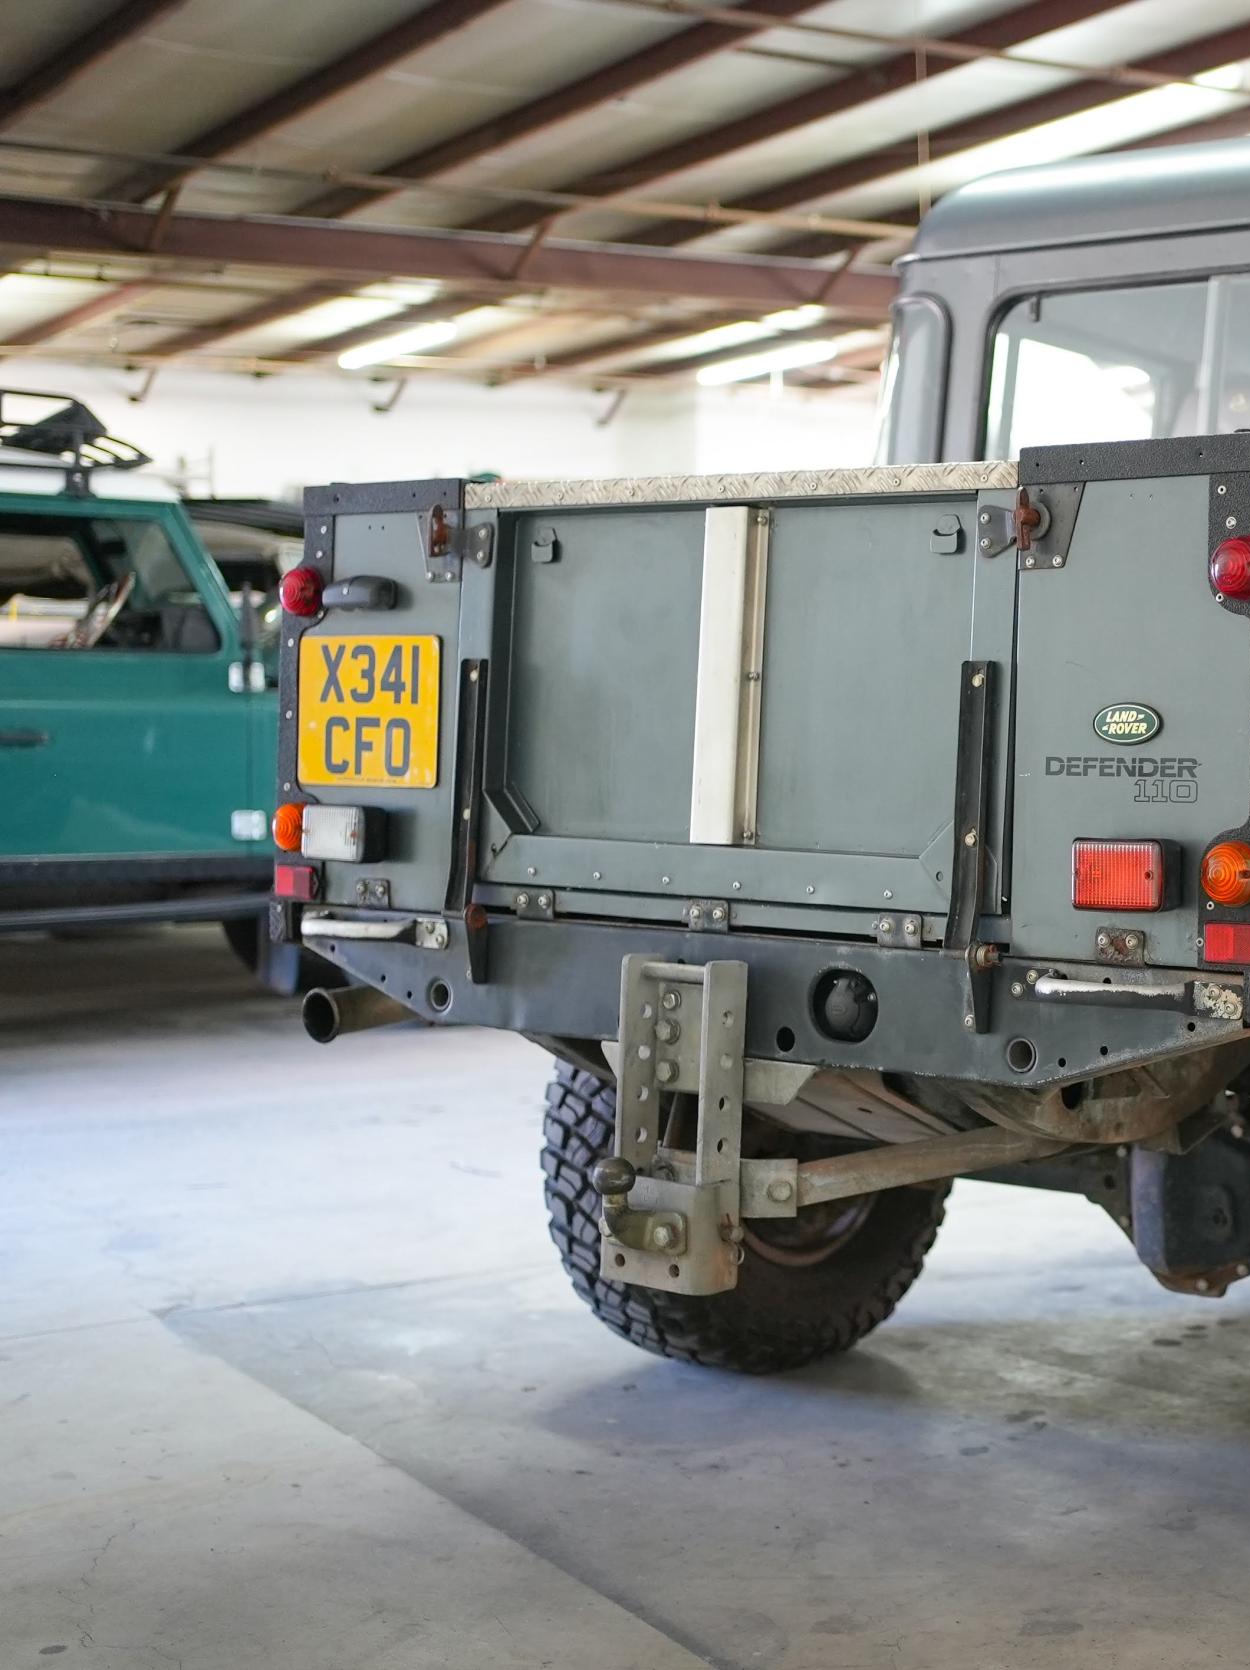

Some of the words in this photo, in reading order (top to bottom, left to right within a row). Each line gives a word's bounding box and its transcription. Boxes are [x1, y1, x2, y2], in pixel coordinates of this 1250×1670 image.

[320, 644, 420, 705] X341
[1106, 710, 1137, 723] LAND
[1108, 723, 1148, 735] ROVER
[324, 716, 411, 777] CFO
[1045, 756, 1199, 778] DEFENDER
[1134, 778, 1198, 803] 110
